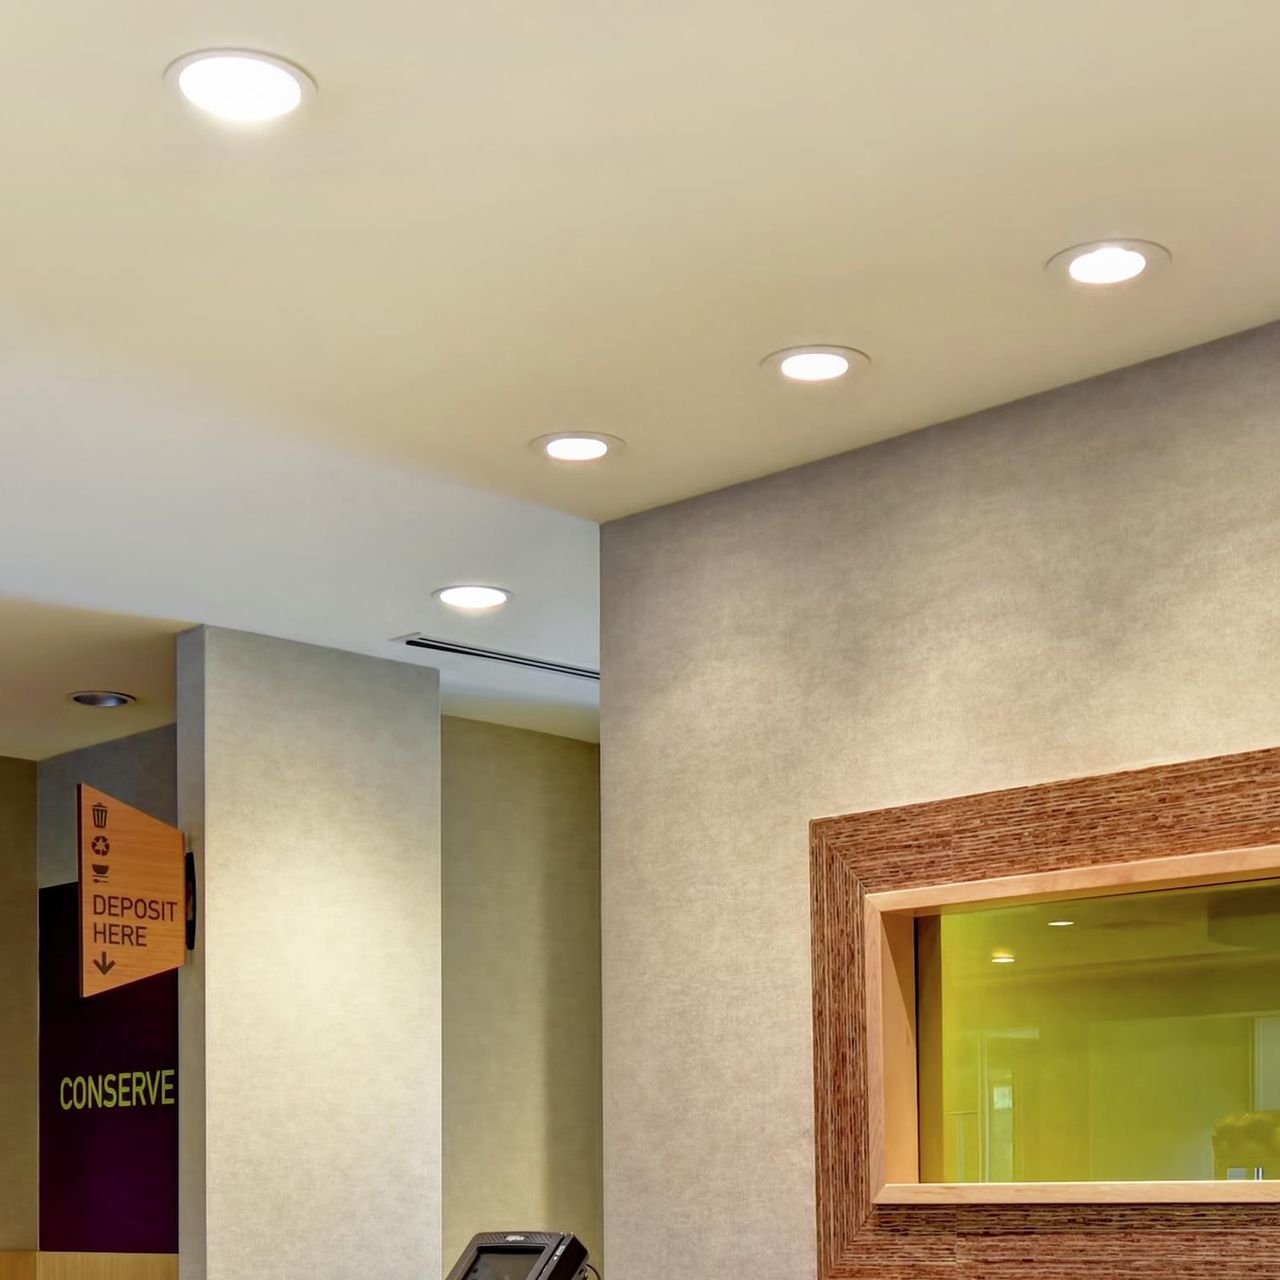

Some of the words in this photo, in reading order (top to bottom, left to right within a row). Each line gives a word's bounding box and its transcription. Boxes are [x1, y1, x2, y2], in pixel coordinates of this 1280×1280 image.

[92, 893, 179, 922] DEPOSIT
[92, 923, 148, 947] HERE
[60, 1069, 175, 1110] CONSERVE
